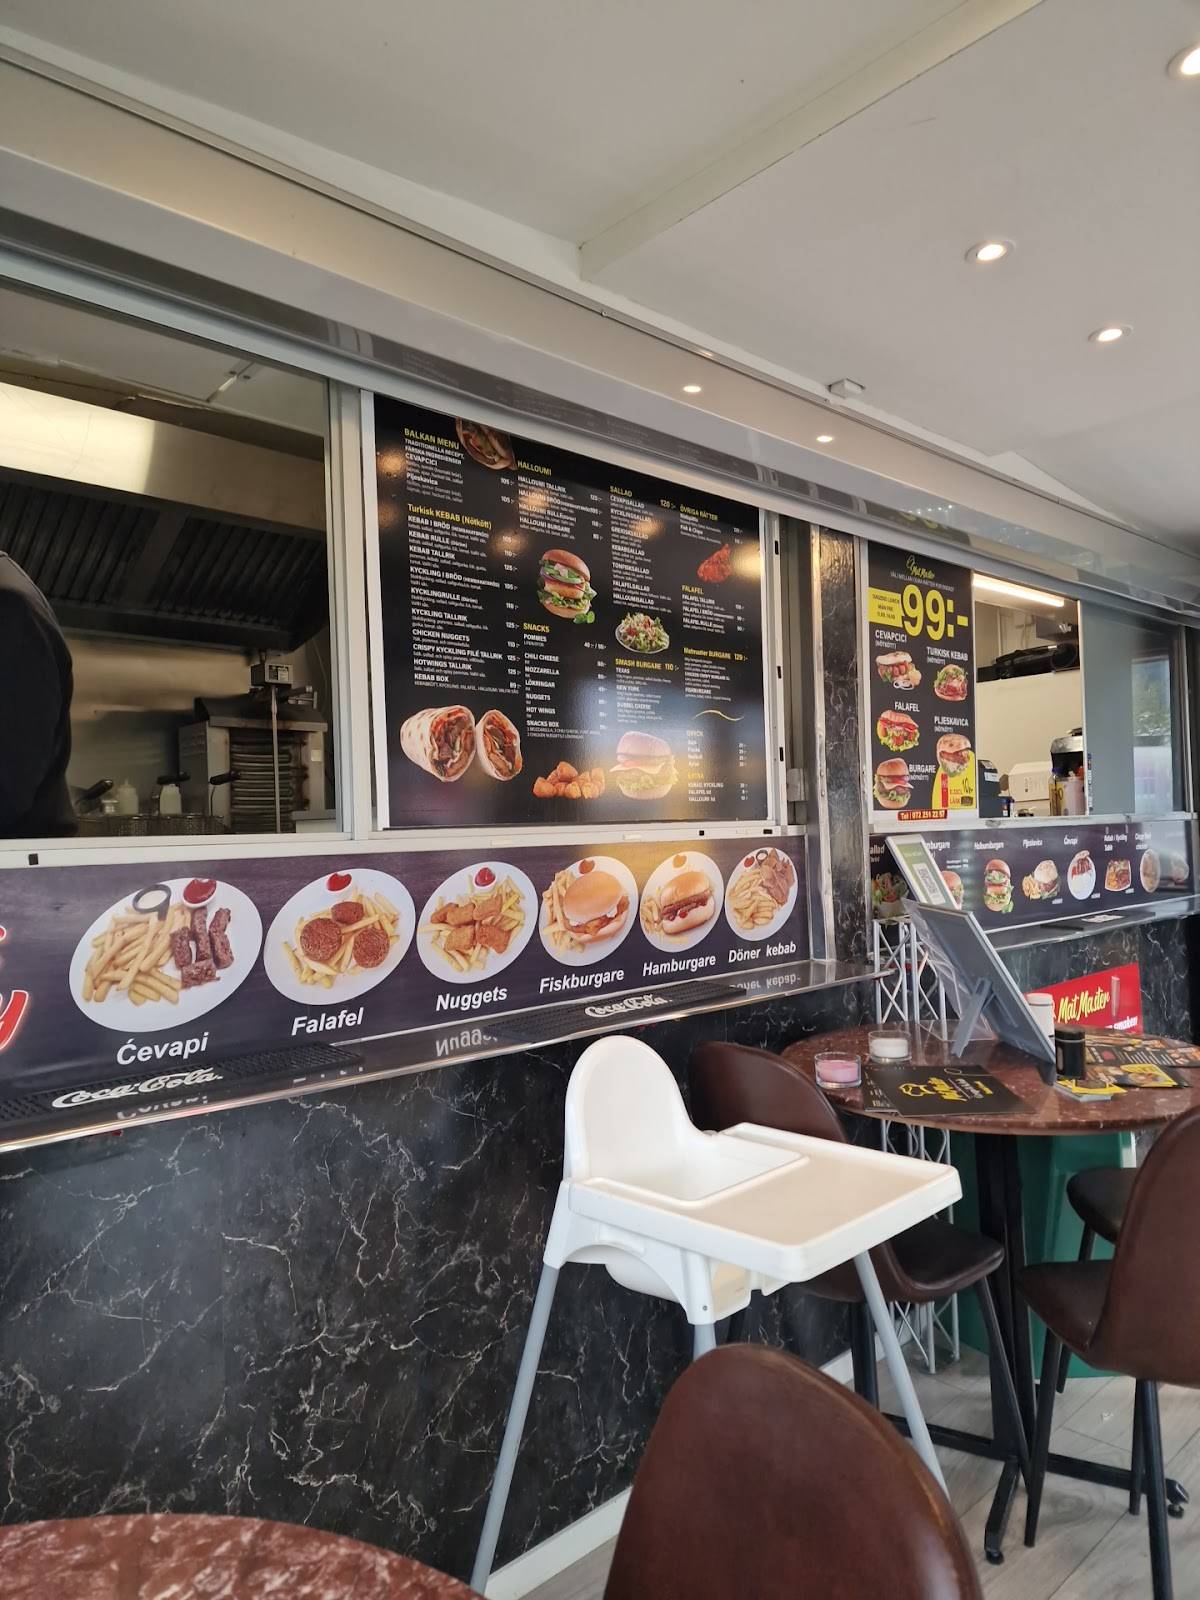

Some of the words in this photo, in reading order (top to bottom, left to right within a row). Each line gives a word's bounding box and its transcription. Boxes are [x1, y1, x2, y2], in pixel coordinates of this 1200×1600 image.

[404, 428, 435, 443] BALKAN
[437, 438, 459, 449] MENU
[517, 461, 551, 476] HALLOUMI
[518, 476, 545, 487] HALLOUMI
[610, 486, 633, 497] SALLAD
[408, 503, 434, 516] Turkisk
[436, 510, 461, 521] KEBAB
[408, 515, 429, 525] KEBAB
[434, 521, 451, 529] BRÖD
[520, 517, 546, 527] HALLOUMI
[409, 530, 429, 541] KEBAB
[431, 534, 450, 544] RULLE
[409, 545, 430, 555] KEBAB
[431, 550, 456, 560] TALLRIK
[410, 566, 441, 578] KYCKLING
[446, 572, 462, 581] BRÖD
[411, 587, 461, 601] KYCKLINGRULLE
[682, 585, 704, 594] FALAFEL
[411, 608, 443, 618] KYCKLING
[444, 613, 468, 622] TALLRIK
[523, 623, 550, 633] SNACKS
[412, 629, 440, 638] CHICKEN
[441, 632, 470, 642] NUGGETS
[524, 634, 547, 642] POMMES
[875, 630, 907, 643] CEVAPCICI
[413, 644, 435, 652] CRISPY
[436, 646, 466, 656] KYCKLING
[480, 651, 503, 660] TALLRIK
[525, 653, 538, 661] CHILI
[539, 654, 560, 662] CHEESE
[709, 650, 731, 659] BURGARE
[926, 646, 950, 658] TURKISK
[951, 650, 968, 661] KEBAB
[413, 658, 447, 668] HOTWINGS
[449, 662, 472, 670] TALLRIK
[525, 666, 560, 675] MOZZARELLA
[615, 658, 635, 667] SMASH
[636, 661, 662, 670] BURGARE
[414, 673, 435, 681] KEBAB
[526, 693, 551, 701] NUGGETS
[895, 701, 920, 712] FALAFEL
[934, 716, 969, 726] PLJESKAVICA
[909, 764, 936, 773] BURGARE
[870, 845, 884, 854] allad
[727, 946, 761, 963] Döner
[765, 940, 797, 957] kebab
[642, 952, 716, 978] Hamburgare
[539, 966, 624, 995] Fiskburgare
[435, 986, 508, 1012] Nuggets
[1058, 995, 1079, 1024] Mat
[1077, 987, 1110, 1021] Master
[291, 1006, 365, 1037] Falafel
[116, 1031, 209, 1066] Ćevapi
[51, 1067, 223, 1109] Coca-Cola
